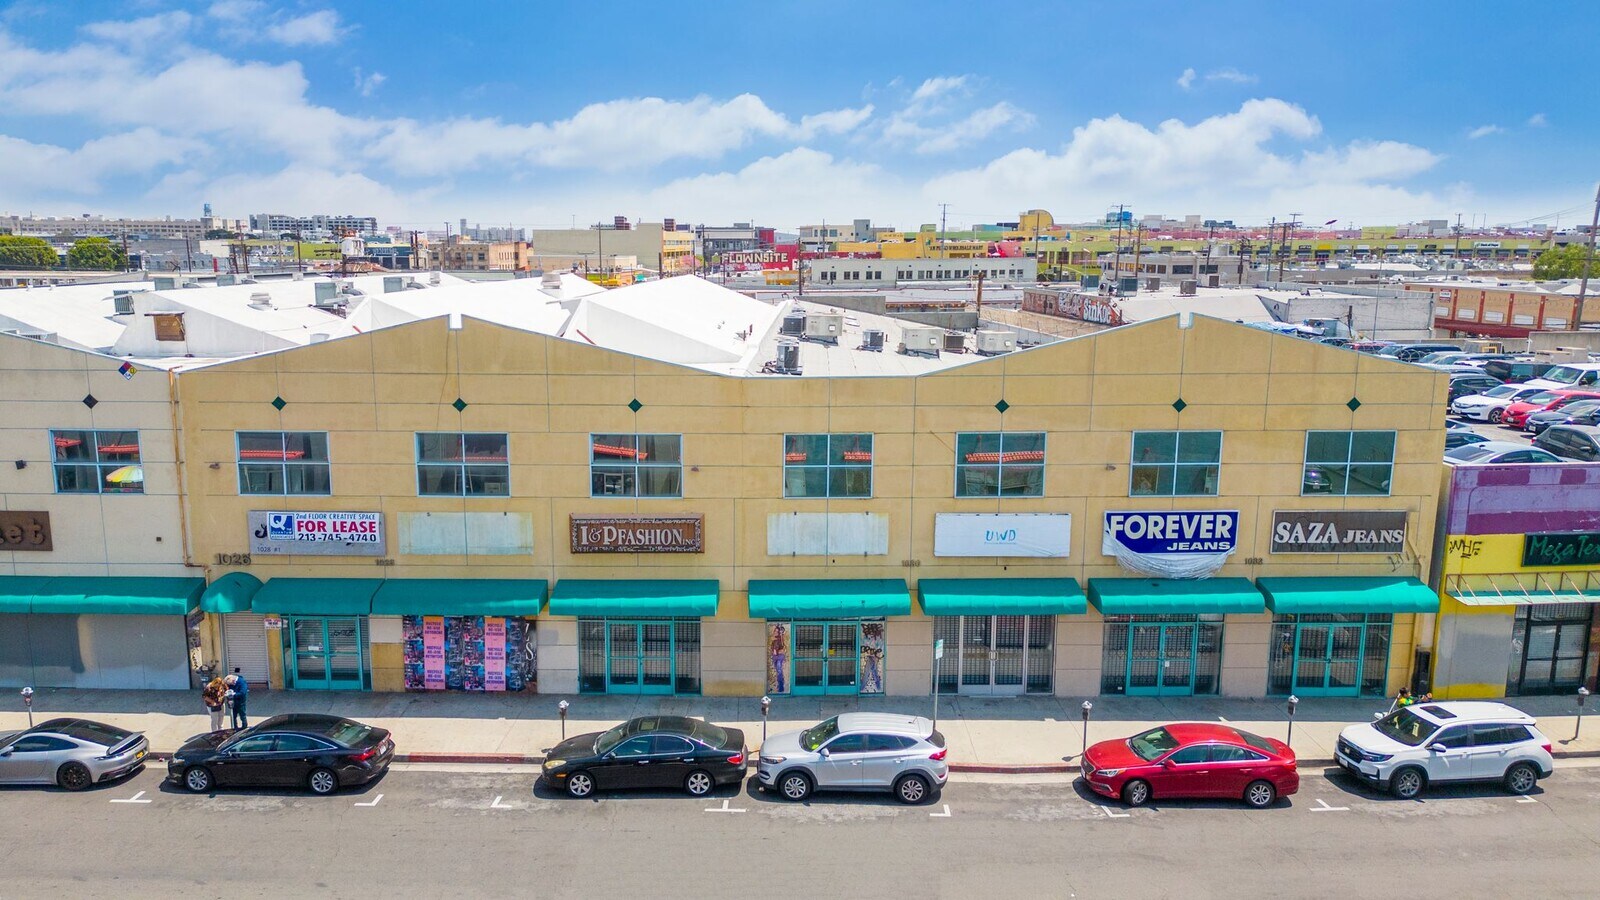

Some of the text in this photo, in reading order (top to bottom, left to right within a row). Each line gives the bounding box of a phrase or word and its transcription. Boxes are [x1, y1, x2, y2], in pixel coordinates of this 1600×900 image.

[297, 521, 376, 533] FOR LEASE
[1110, 515, 1232, 540] FOREVER
[1274, 522, 1404, 544] SAZA JEANS
[298, 534, 377, 542] 213-745-4740
[618, 529, 683, 545] FASHION
[1167, 542, 1230, 551] JEANS
